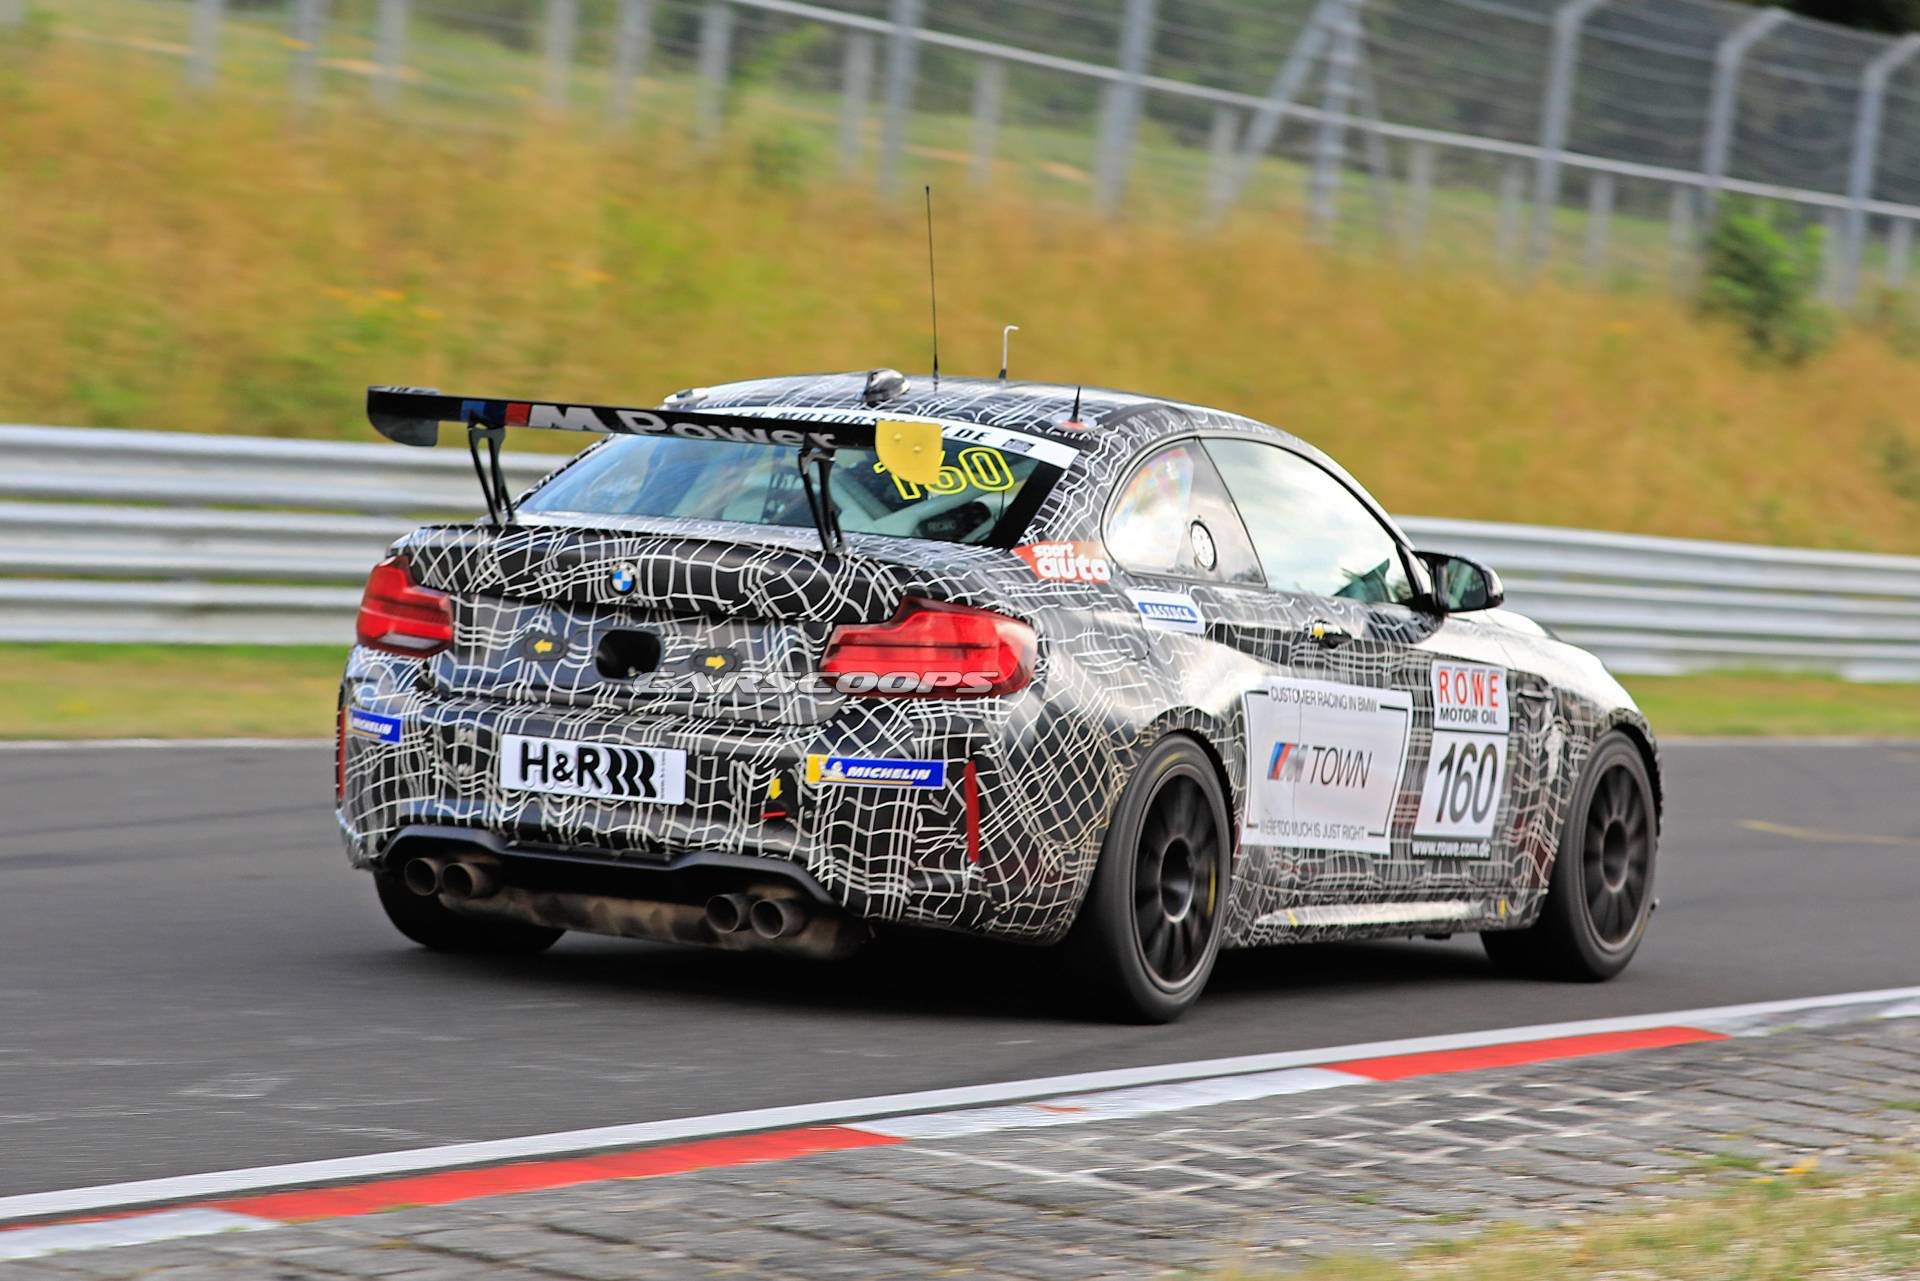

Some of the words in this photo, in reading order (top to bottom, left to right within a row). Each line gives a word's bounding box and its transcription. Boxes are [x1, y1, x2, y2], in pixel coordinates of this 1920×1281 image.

[528, 404, 611, 432] M
[615, 411, 837, 449] Power
[1032, 543, 1073, 558] sport
[1037, 556, 1111, 580] auto
[1439, 671, 1500, 707] ROWE
[1439, 707, 1478, 724] MOTOR
[1481, 711, 1498, 725] OIL
[521, 741, 604, 790] H&R
[846, 765, 931, 780] MICHELIN
[1310, 746, 1373, 788] TOWN
[1436, 742, 1498, 823] 160
